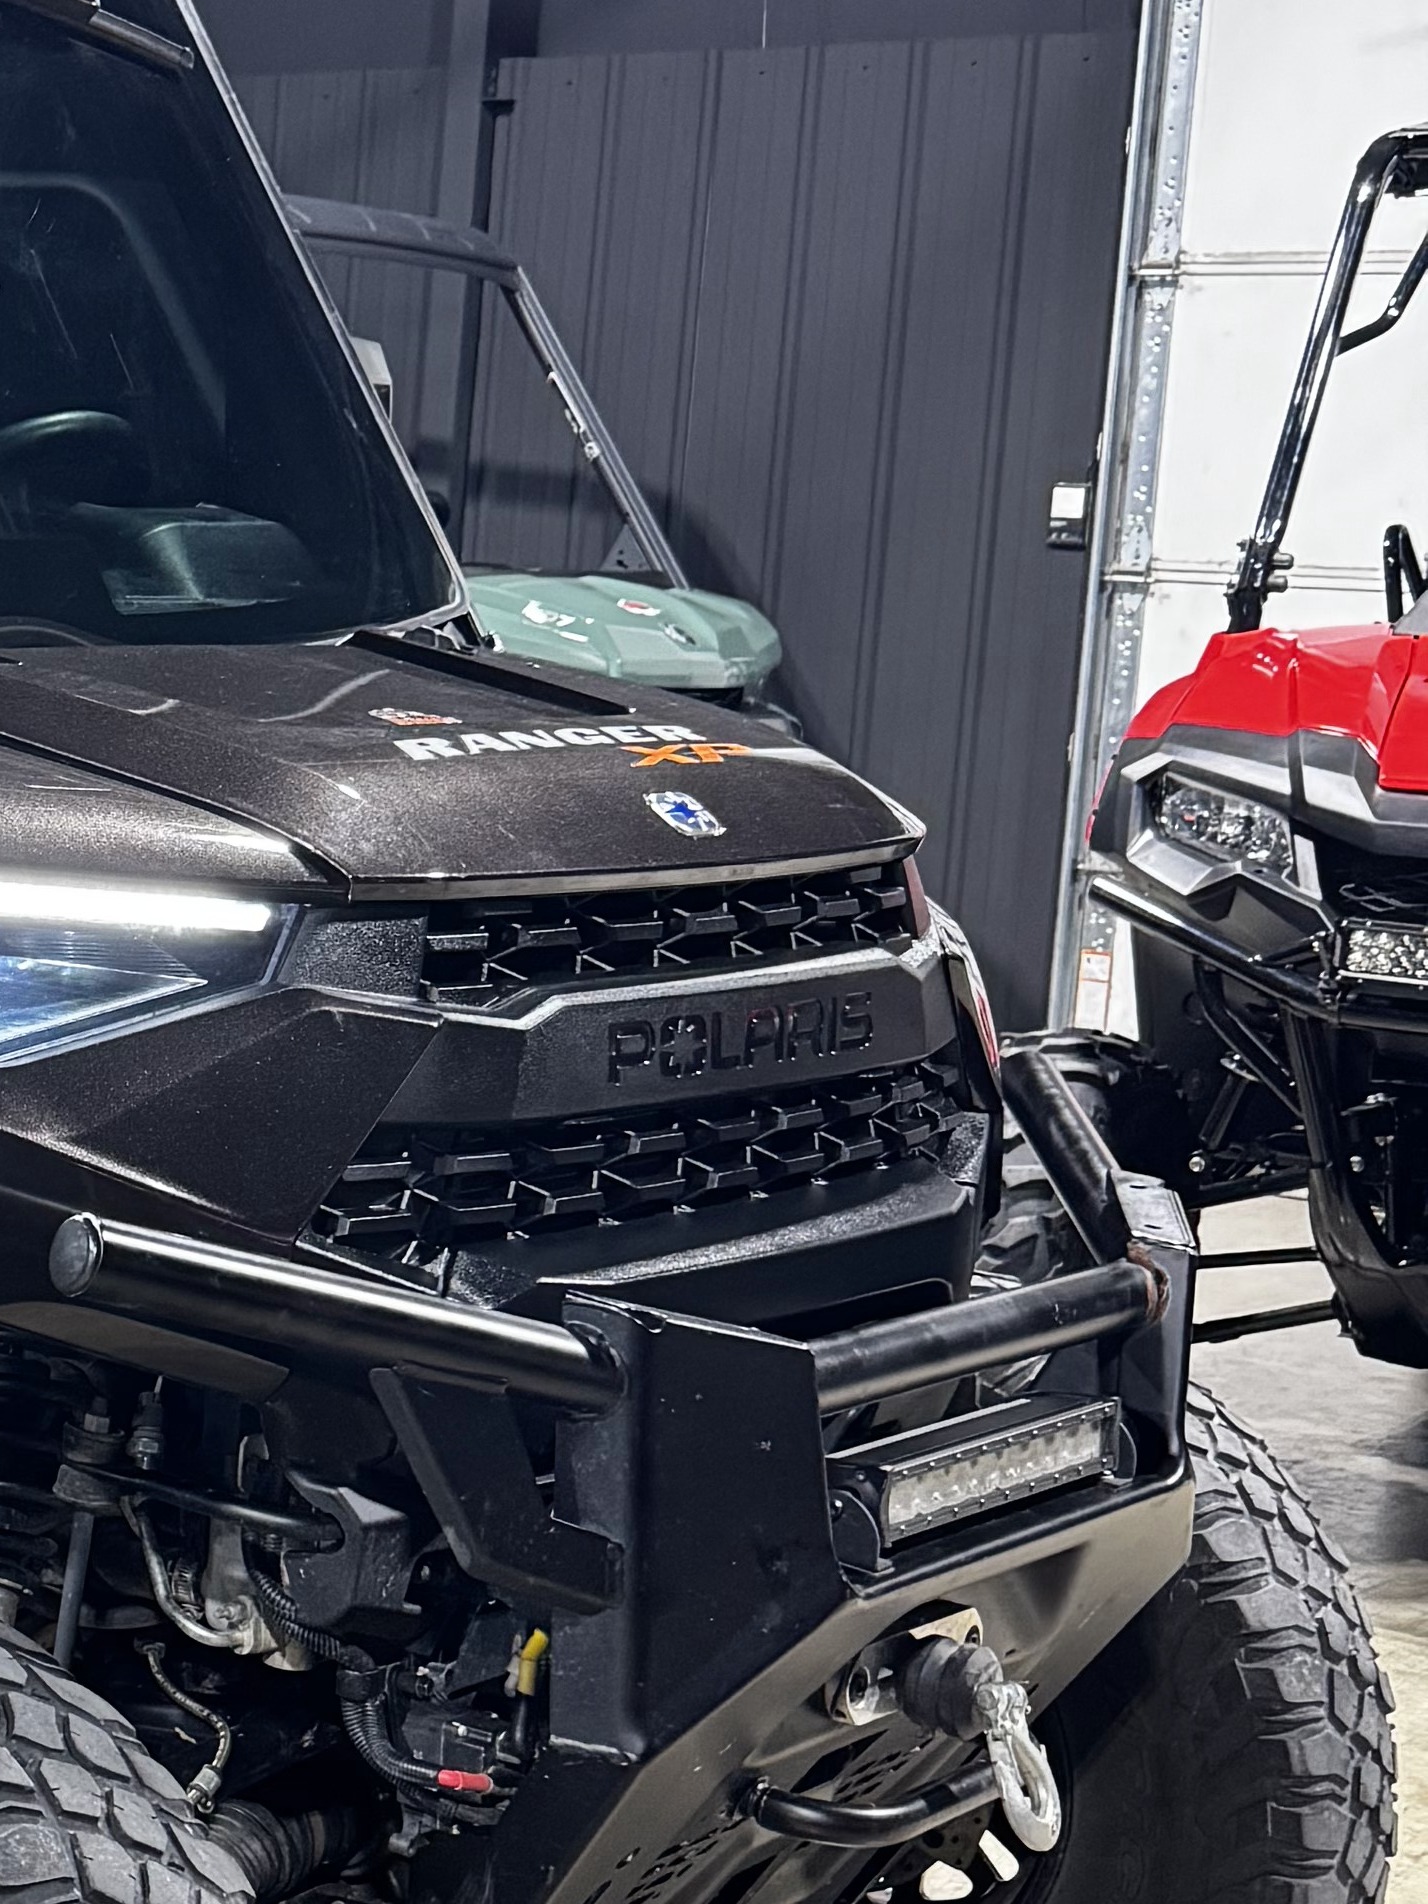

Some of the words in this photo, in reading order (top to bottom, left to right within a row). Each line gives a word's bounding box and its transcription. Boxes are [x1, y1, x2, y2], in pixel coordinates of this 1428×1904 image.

[393, 725, 707, 760] RANGER
[619, 743, 754, 767] XP
[608, 991, 874, 1086] POLARIS
